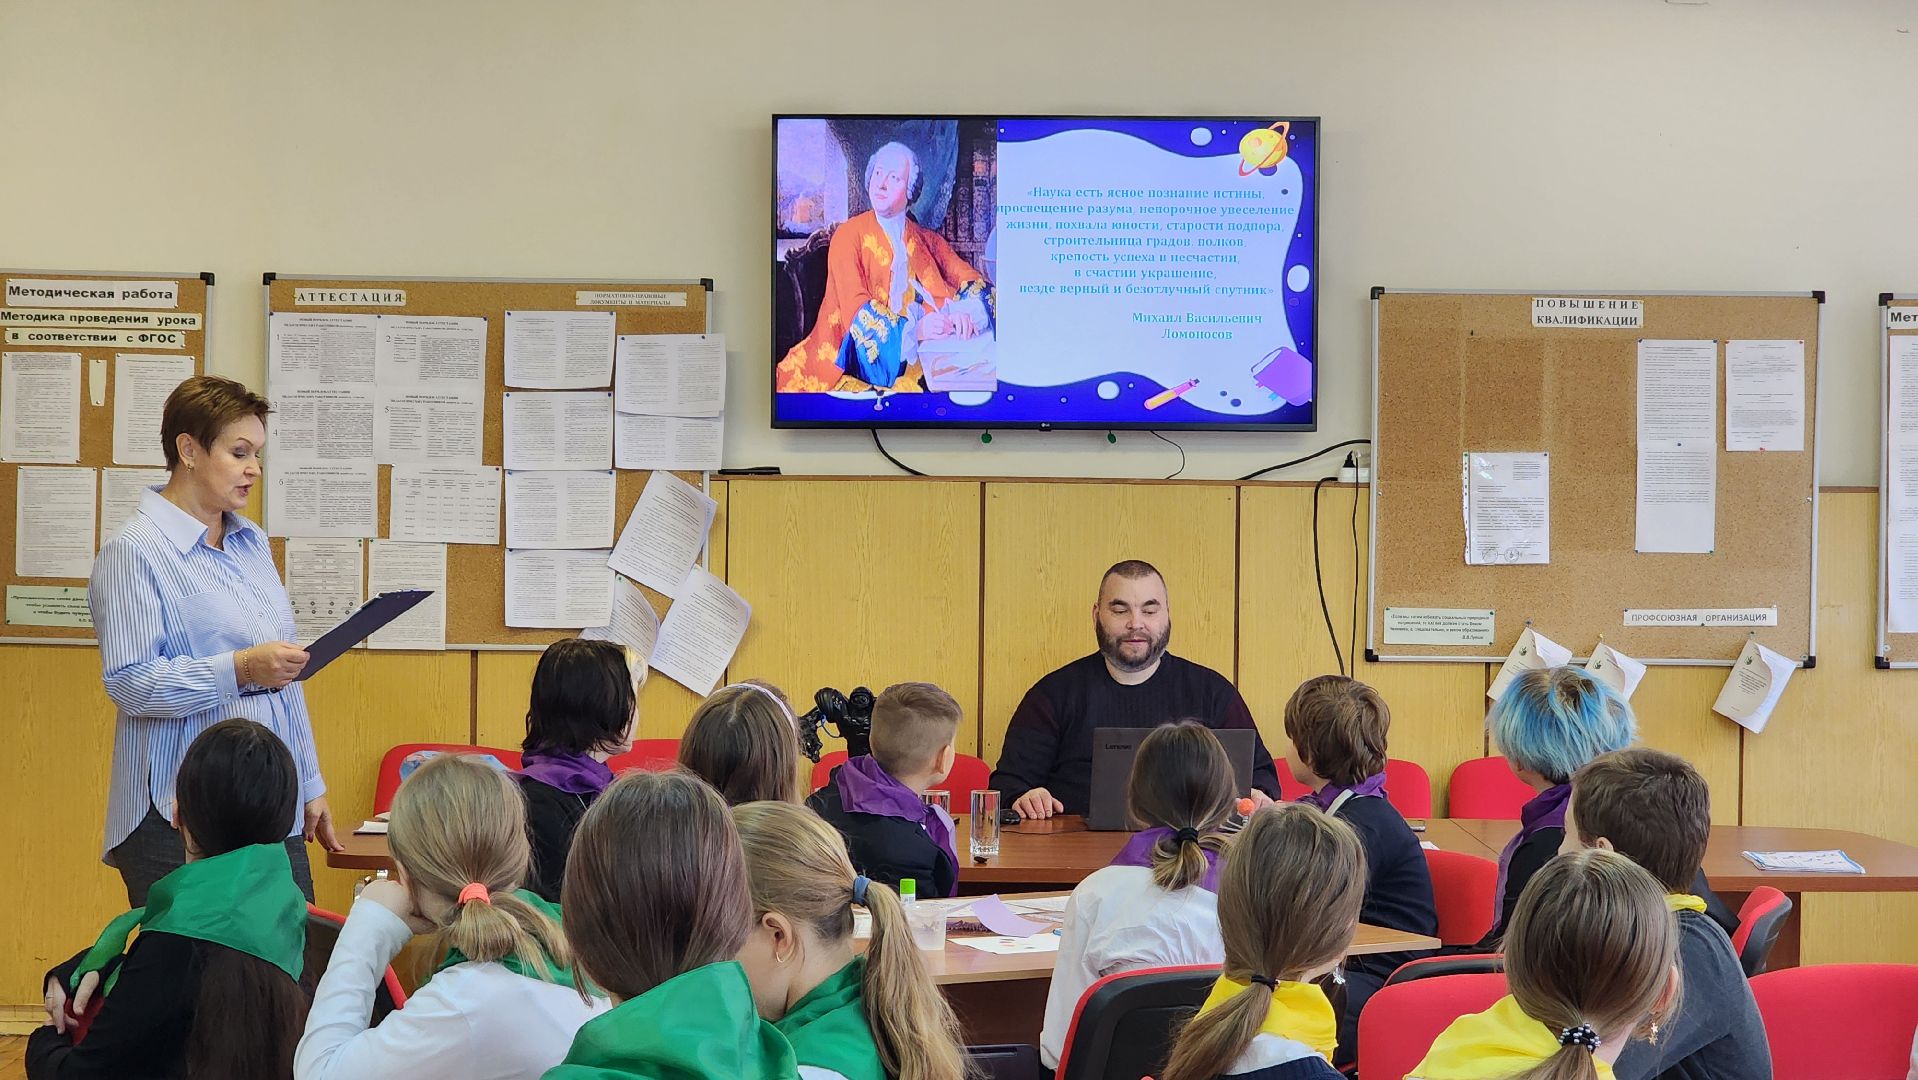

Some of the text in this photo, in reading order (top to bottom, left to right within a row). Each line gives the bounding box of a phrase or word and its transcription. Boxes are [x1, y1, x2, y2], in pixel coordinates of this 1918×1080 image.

[1076, 188, 1103, 198] есть
[1107, 188, 1144, 198] ясное
[1148, 189, 1209, 199] познание
[1140, 206, 1217, 217] непорочное
[1220, 207, 1295, 217] увеселение
[1055, 221, 1107, 230] похвала
[1166, 222, 1223, 232] старости
[1044, 236, 1142, 247] строительница
[1051, 252, 1109, 263] крепость
[1113, 253, 1155, 264] успеха
[1085, 269, 1137, 278] счастии
[1141, 269, 1217, 280] украшение,
[8, 285, 173, 301] Методическая работа
[1060, 283, 1110, 295] верный
[1113, 284, 1121, 293] и
[1125, 284, 1211, 296] безотлучный
[297, 292, 403, 304] АТТЕСТАЦИЯ
[1536, 299, 1639, 310] ПОВЫШЕНИЕ
[0, 311, 196, 326] Методика проведения урока
[1132, 312, 1263, 323] Михаил Васильевич
[1536, 315, 1638, 327] КВАЛИФИКАЦИИ
[11, 331, 176, 344] в соответствии с ФГОС
[1161, 328, 1233, 339] Ломоносов
[1631, 614, 1767, 623] ПРОФСОЮЗНАЯ ОРГАНИЗАЦИЯ
